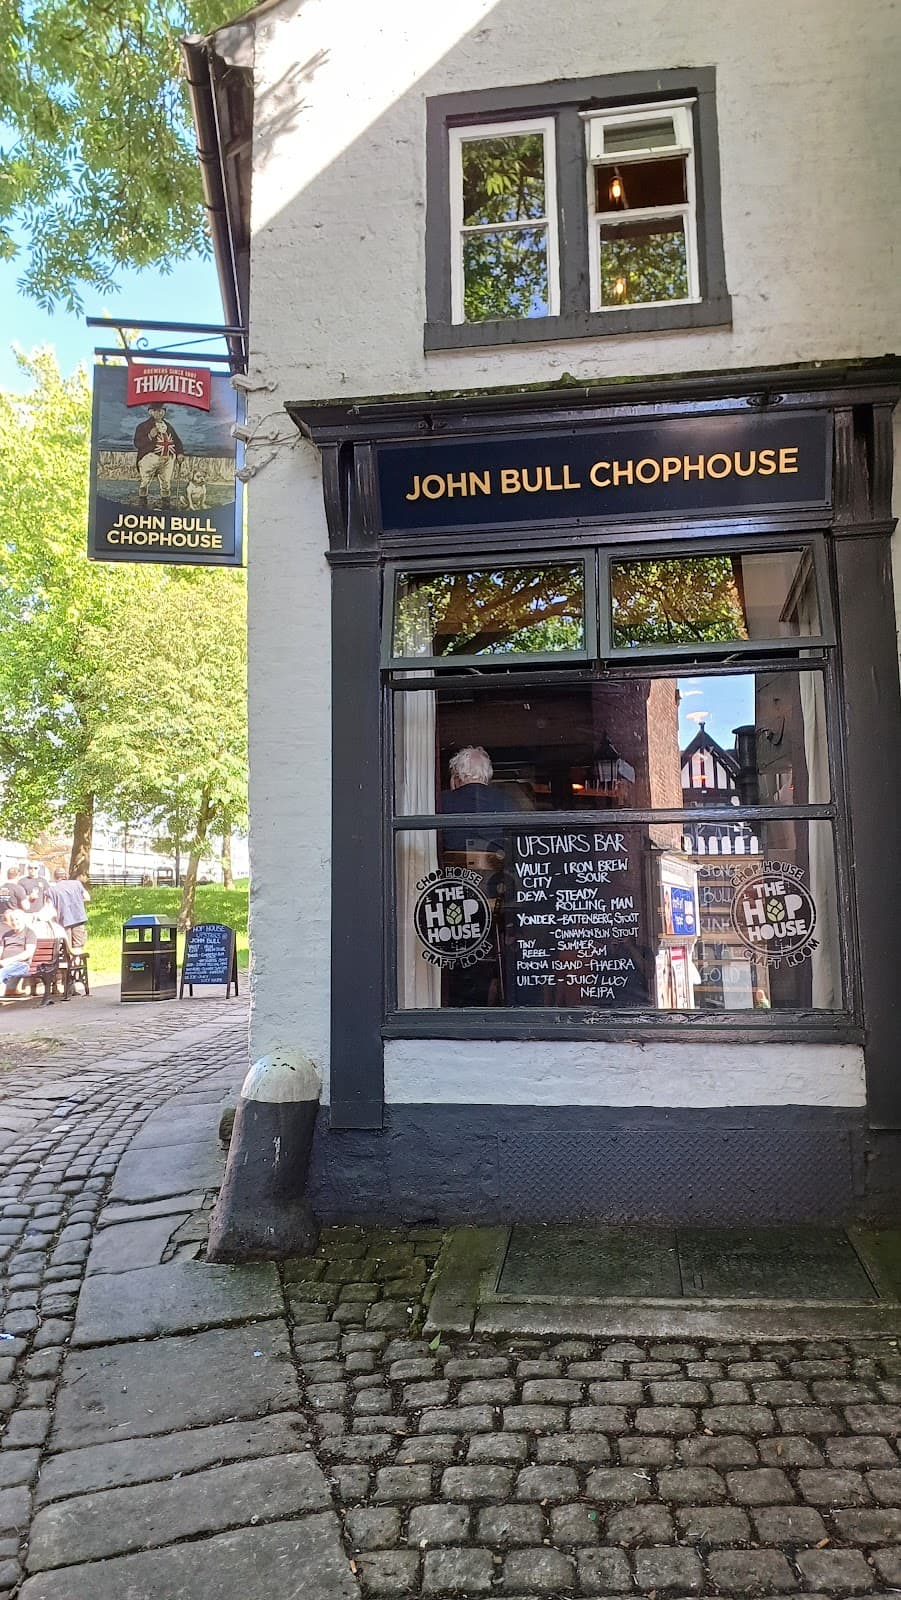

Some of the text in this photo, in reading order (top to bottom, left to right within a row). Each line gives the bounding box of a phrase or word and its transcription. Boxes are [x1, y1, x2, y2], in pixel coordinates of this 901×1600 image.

[133, 374, 204, 397] THWAITES
[406, 447, 799, 501] JOHN BULL CHOPHOUSE
[113, 514, 217, 532] JOHN BULL
[106, 530, 223, 549] CHOPHOUSE
[516, 832, 628, 858] UPSTAIRS BAR
[515, 861, 551, 878] VAULT
[564, 861, 593, 875] IRON
[598, 858, 629, 872] BREW
[730, 861, 804, 887] CHOP HOUSE
[416, 867, 483, 891] CHOP HOUSE
[523, 872, 611, 888] CITY SOUR
[435, 886, 465, 902] THE
[516, 890, 548, 902] DEYA
[556, 888, 598, 902] STEADY
[753, 881, 786, 898] THE
[555, 896, 634, 912] ROLLING MAN
[516, 913, 557, 927] YONDER
[427, 923, 481, 944] HOUSE
[612, 927, 639, 938] STOUT
[747, 919, 808, 942] HOUSE
[517, 939, 536, 949] TINY
[557, 940, 594, 951] SUMMER
[522, 945, 607, 959] REBEL SLAM
[786, 938, 820, 967] ROOM
[421, 940, 493, 970] CRAFT ROOM
[552, 960, 582, 971] ISLAND
[590, 959, 635, 971] PHAEDRA
[566, 974, 598, 985] JUICY
[601, 975, 628, 987] LUCY
[580, 986, 615, 999] NEIPA
